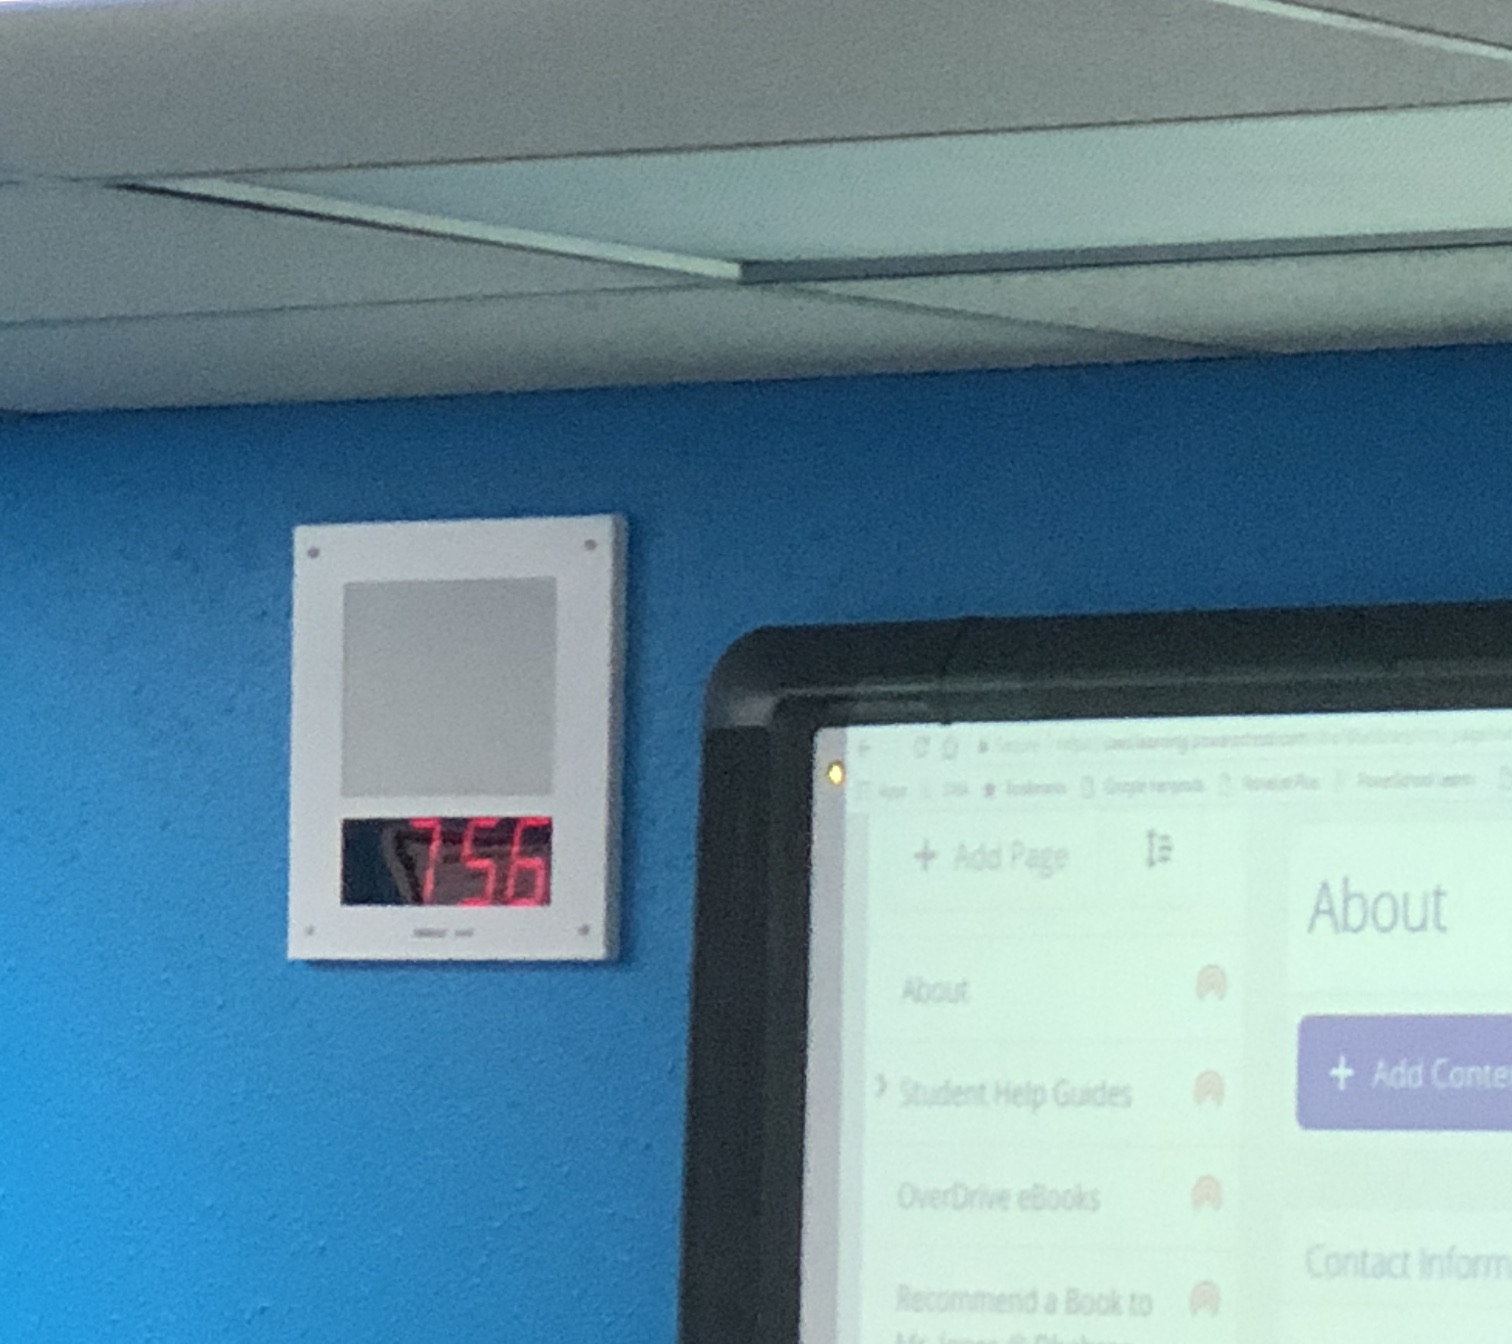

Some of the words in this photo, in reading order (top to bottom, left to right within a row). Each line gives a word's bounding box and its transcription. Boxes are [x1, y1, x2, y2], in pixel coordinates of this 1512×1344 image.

[954, 843, 1002, 871] Add
[1011, 843, 1069, 877] Page
[1306, 876, 1449, 936] About
[902, 977, 969, 1004] About
[1372, 1059, 1424, 1090] Add
[901, 1078, 988, 1107] Student
[995, 1080, 1046, 1111] Help
[1053, 1080, 1133, 1109] Guides
[898, 1182, 1011, 1211] OverDrive
[1018, 1184, 1101, 1213] eBooks
[1305, 1243, 1411, 1280] Contact
[896, 1284, 1039, 1316] Recommend
[1045, 1294, 1058, 1315] a
[1065, 1286, 1123, 1318] Book
[1130, 1290, 1153, 1317] to
